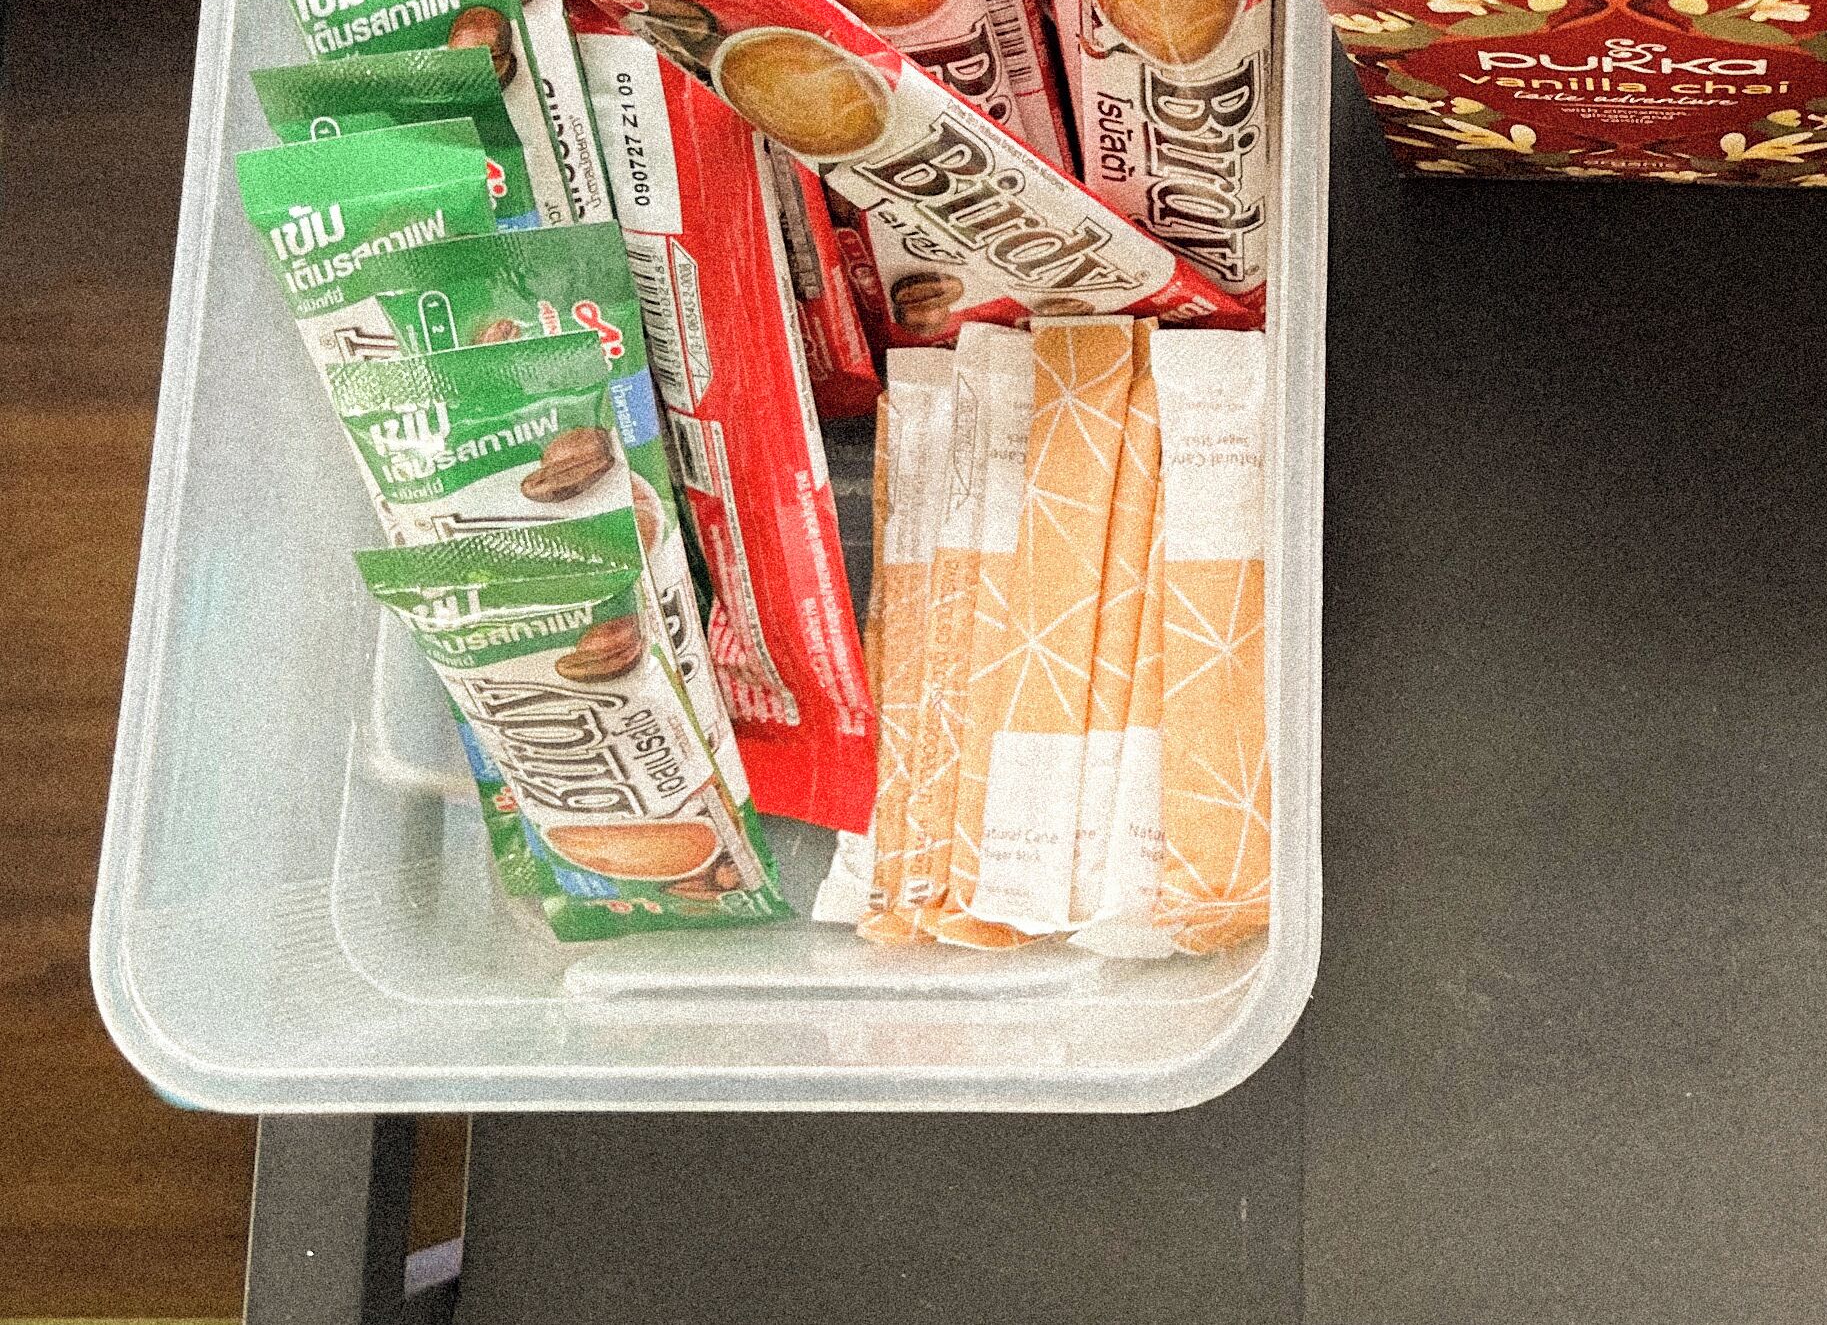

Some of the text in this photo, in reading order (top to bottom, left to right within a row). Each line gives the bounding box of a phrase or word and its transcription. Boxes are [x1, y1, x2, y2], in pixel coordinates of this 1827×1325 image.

[1459, 72, 1789, 95] vanilla chai
[1594, 93, 1740, 107] adventure
[616, 72, 651, 208] 090727 Z1 09
[1096, 90, 1138, 183] โรบัสต้า
[1138, 48, 1267, 283] Birdy
[270, 203, 345, 261] เข้ม
[851, 110, 1148, 294] Birdy
